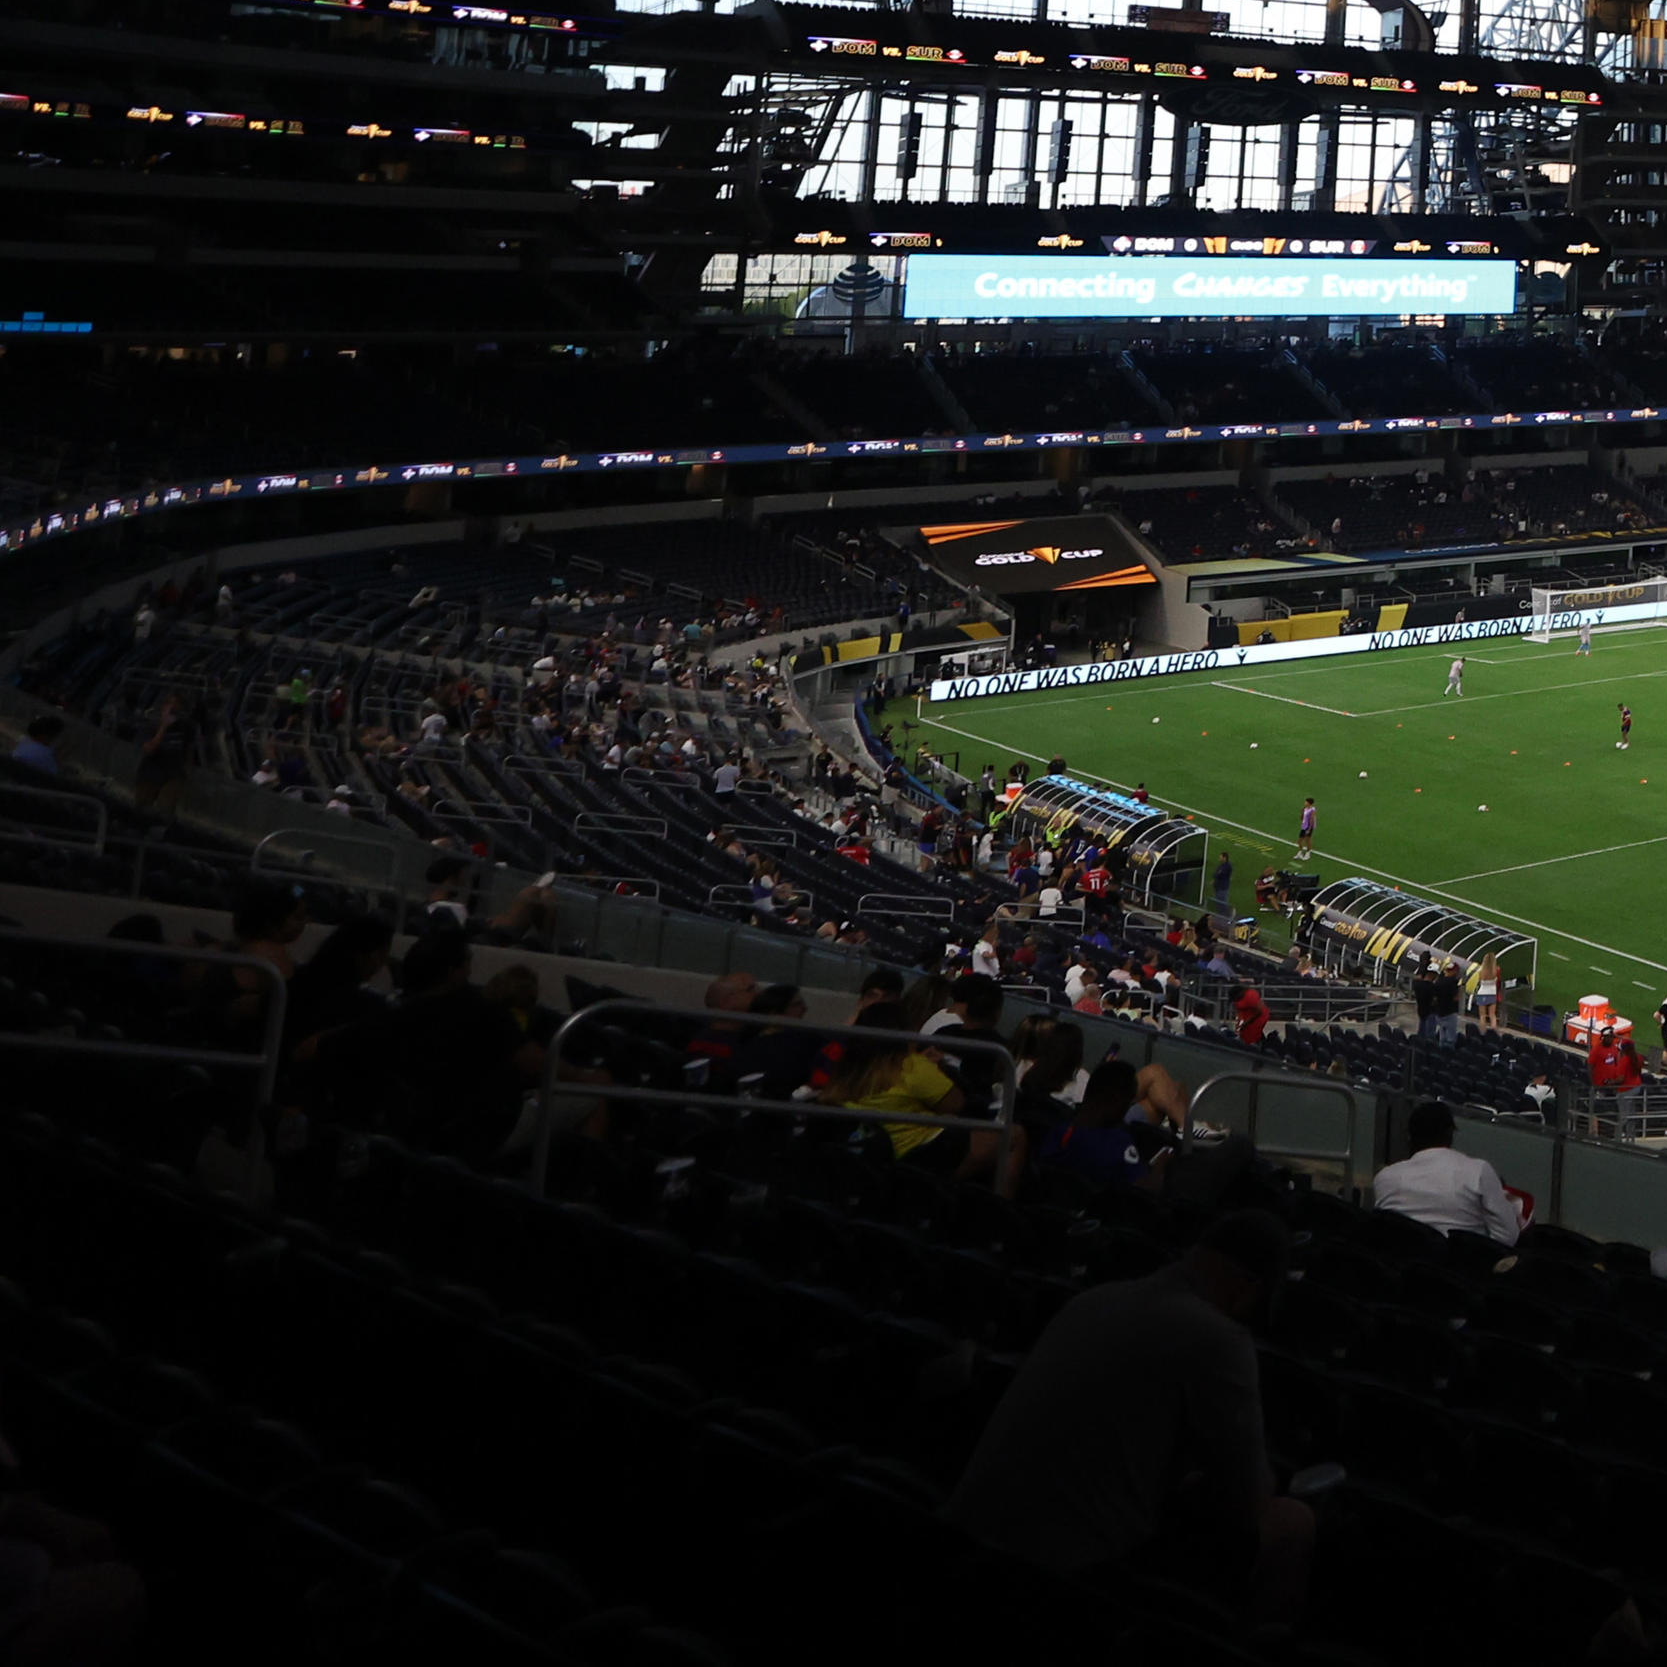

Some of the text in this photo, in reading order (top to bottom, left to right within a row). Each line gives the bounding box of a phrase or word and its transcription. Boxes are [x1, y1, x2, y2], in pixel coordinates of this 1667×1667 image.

[974, 271, 1468, 304] Connecting CHANGES Everything
[974, 549, 1104, 566] GOLD CUP
[1615, 585, 1644, 600] CUP
[1369, 632, 1394, 650] NO
[1398, 628, 1433, 647] ONE
[1438, 623, 1474, 642] WAS
[1477, 617, 1525, 637] BORN
[1527, 615, 1535, 632] A
[946, 680, 980, 699] NO
[991, 673, 1031, 694] ONE
[1037, 667, 1082, 688] WAS
[1086, 660, 1145, 683] BORN
[1149, 657, 1161, 675] A
